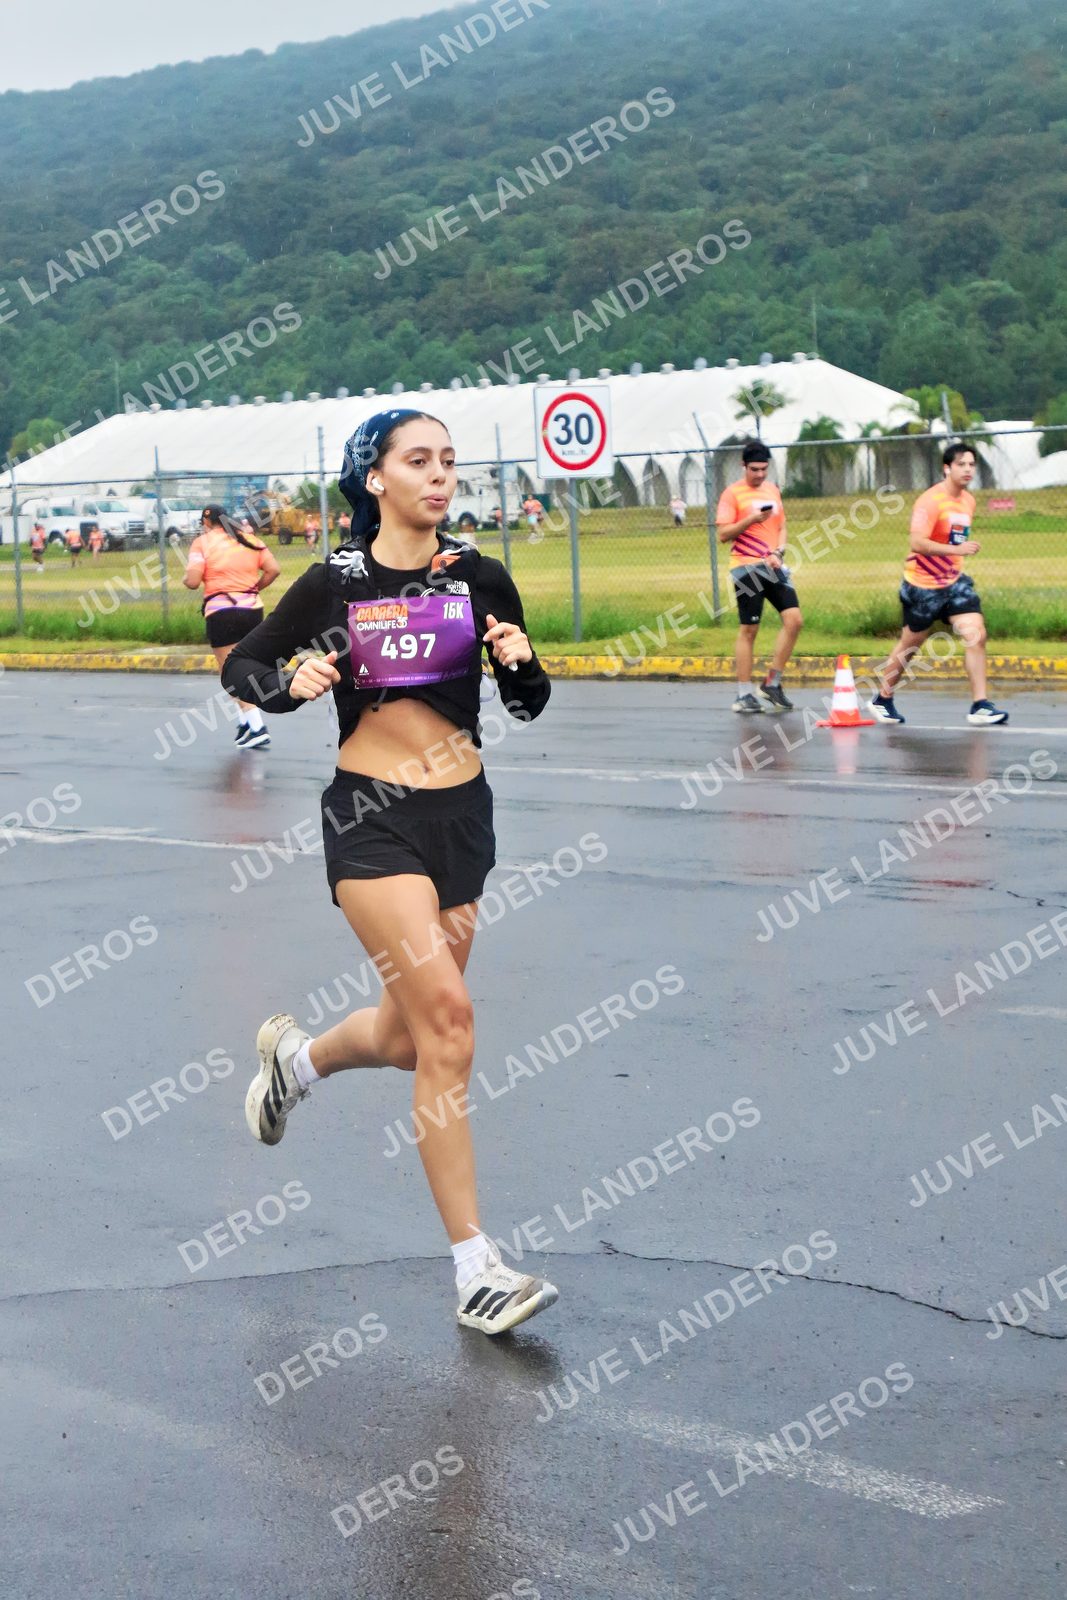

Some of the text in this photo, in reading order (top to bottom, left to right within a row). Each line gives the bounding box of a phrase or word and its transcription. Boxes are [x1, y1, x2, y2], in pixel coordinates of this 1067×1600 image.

[553, 413, 594, 446] 30
[356, 604, 408, 622] CARRERA
[381, 633, 436, 660] 497
